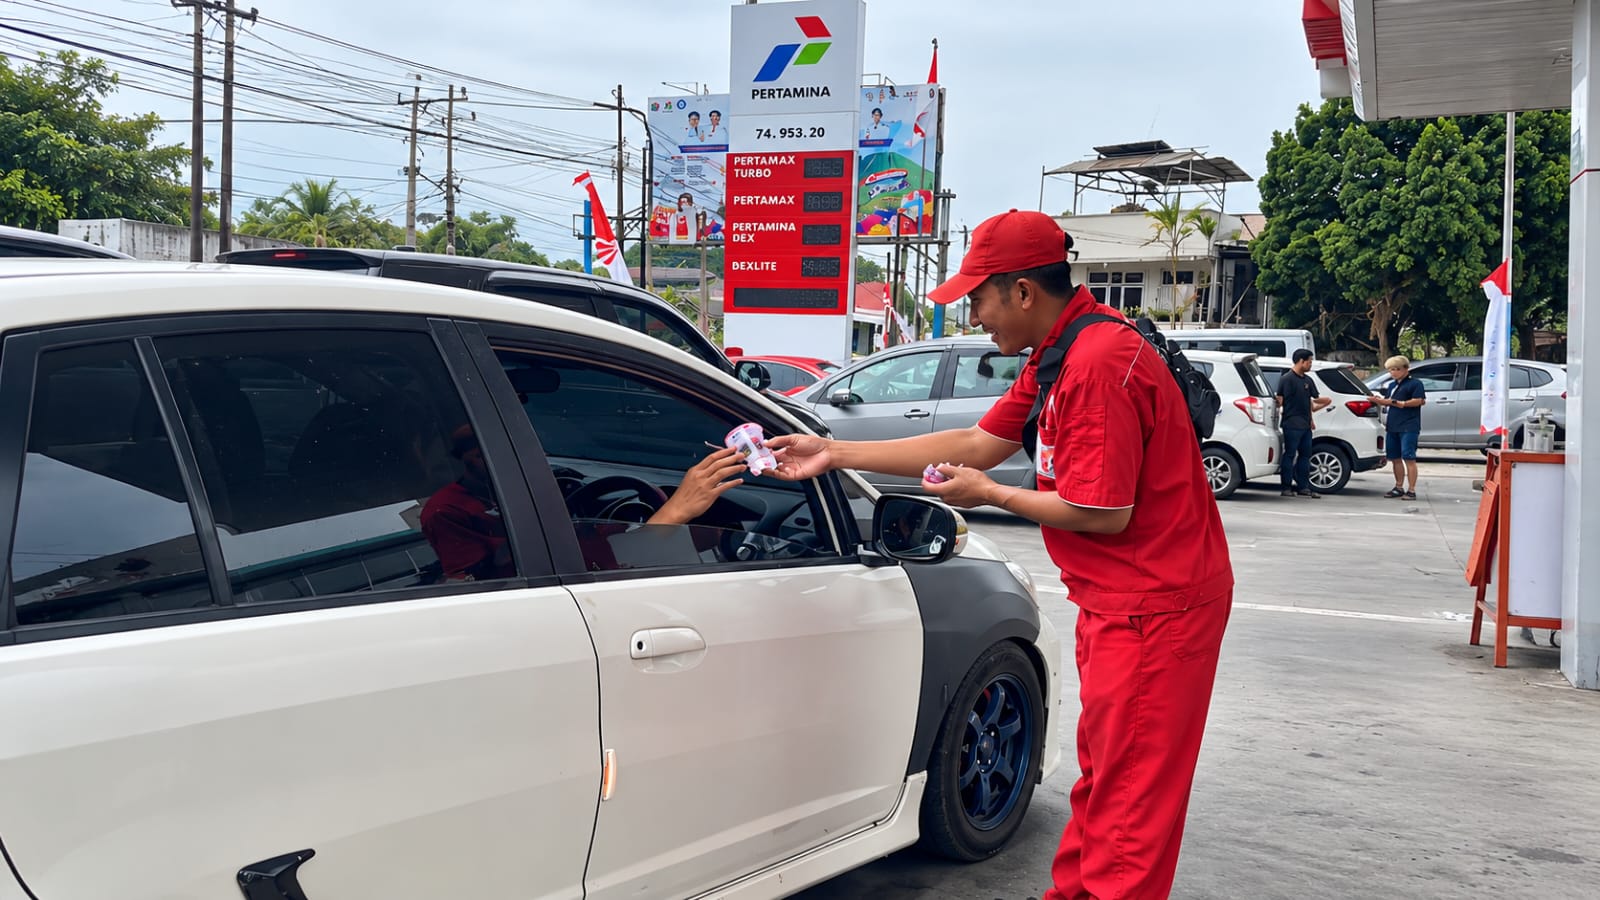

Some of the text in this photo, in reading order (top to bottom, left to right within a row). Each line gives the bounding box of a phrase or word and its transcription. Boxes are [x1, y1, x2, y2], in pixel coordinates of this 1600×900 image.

[751, 86, 831, 100] PERTAMINA
[734, 155, 795, 166] PERTAMAX
[734, 168, 772, 178] TURBO
[733, 195, 795, 205] PERTAMAX
[732, 222, 796, 232] PERTAMINA
[732, 233, 755, 243] DEX
[732, 261, 777, 271] DEXLITE
